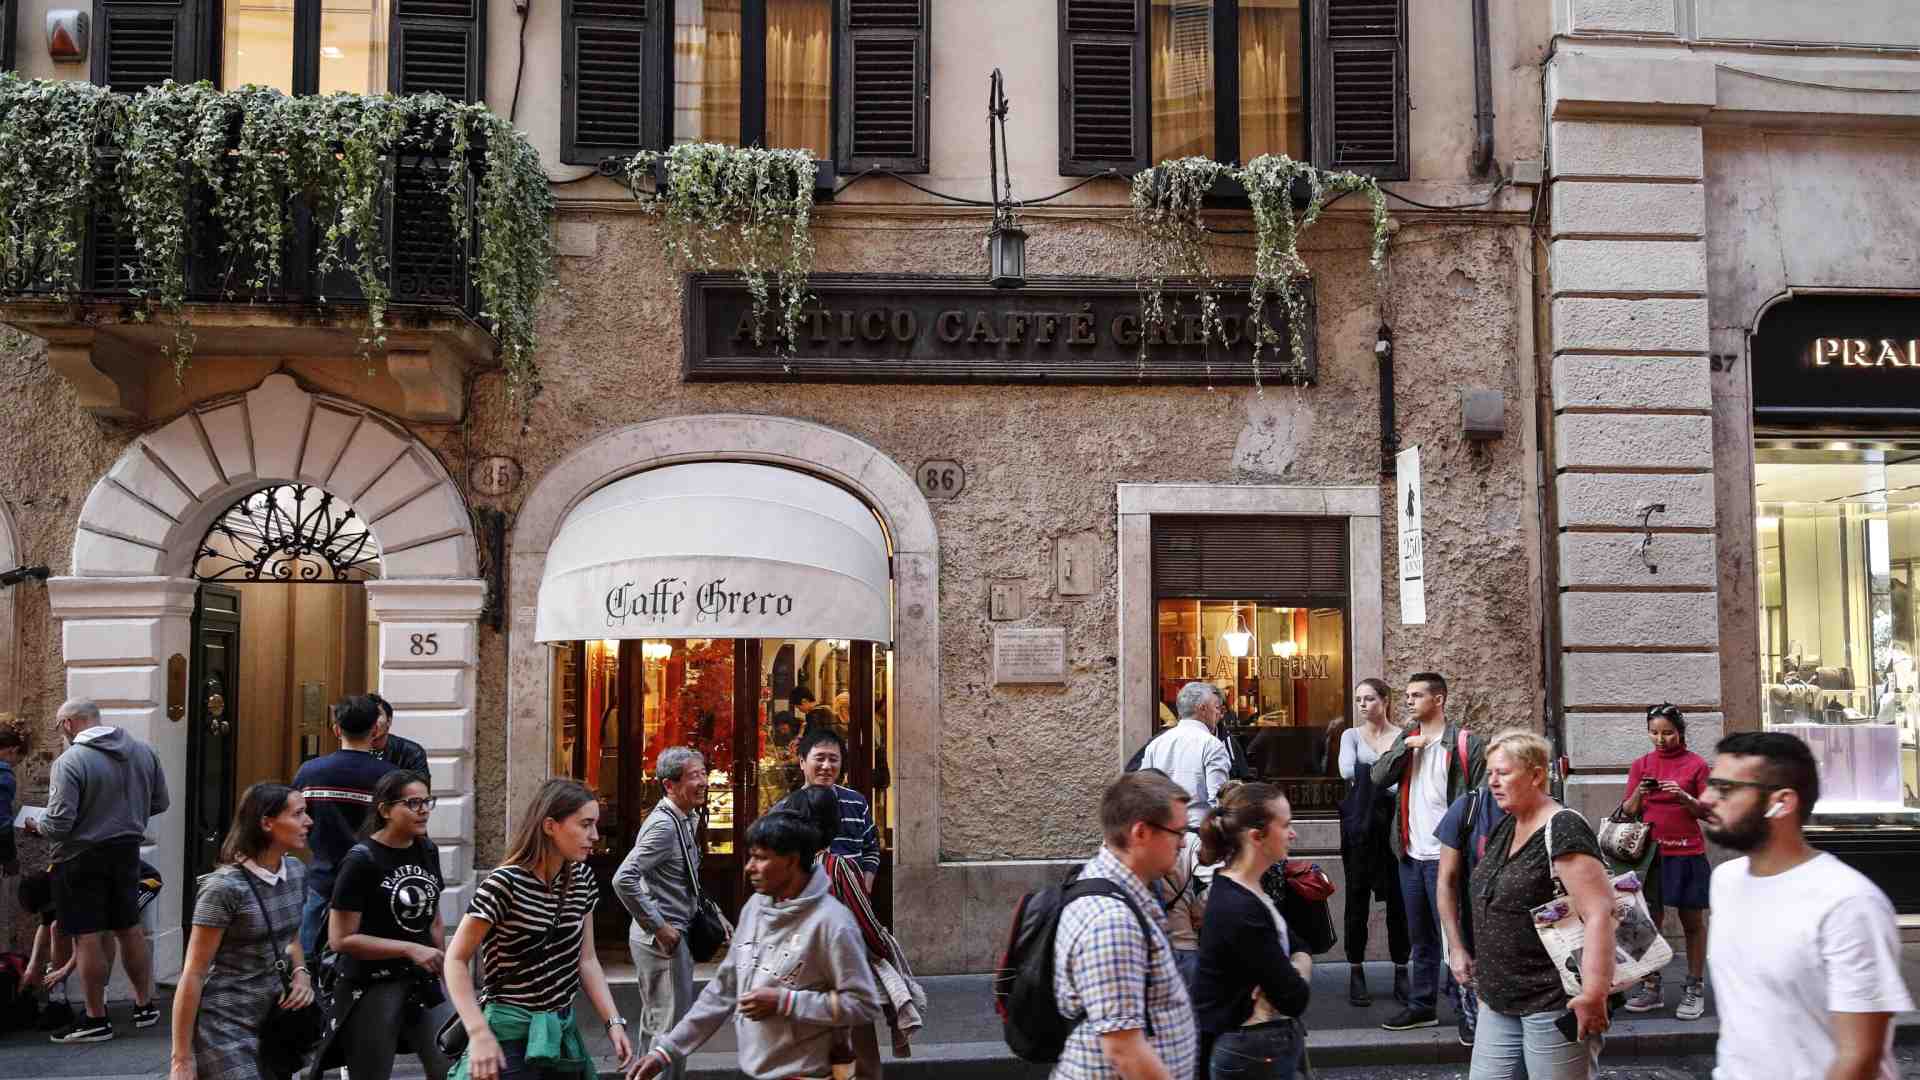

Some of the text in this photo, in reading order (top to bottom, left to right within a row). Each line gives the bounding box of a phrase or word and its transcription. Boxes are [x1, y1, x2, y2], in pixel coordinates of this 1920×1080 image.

[927, 468, 954, 490] 86
[697, 577, 793, 625] Greco
[410, 632, 438, 656] 85
[1176, 655, 1329, 680] TEA ROOM
